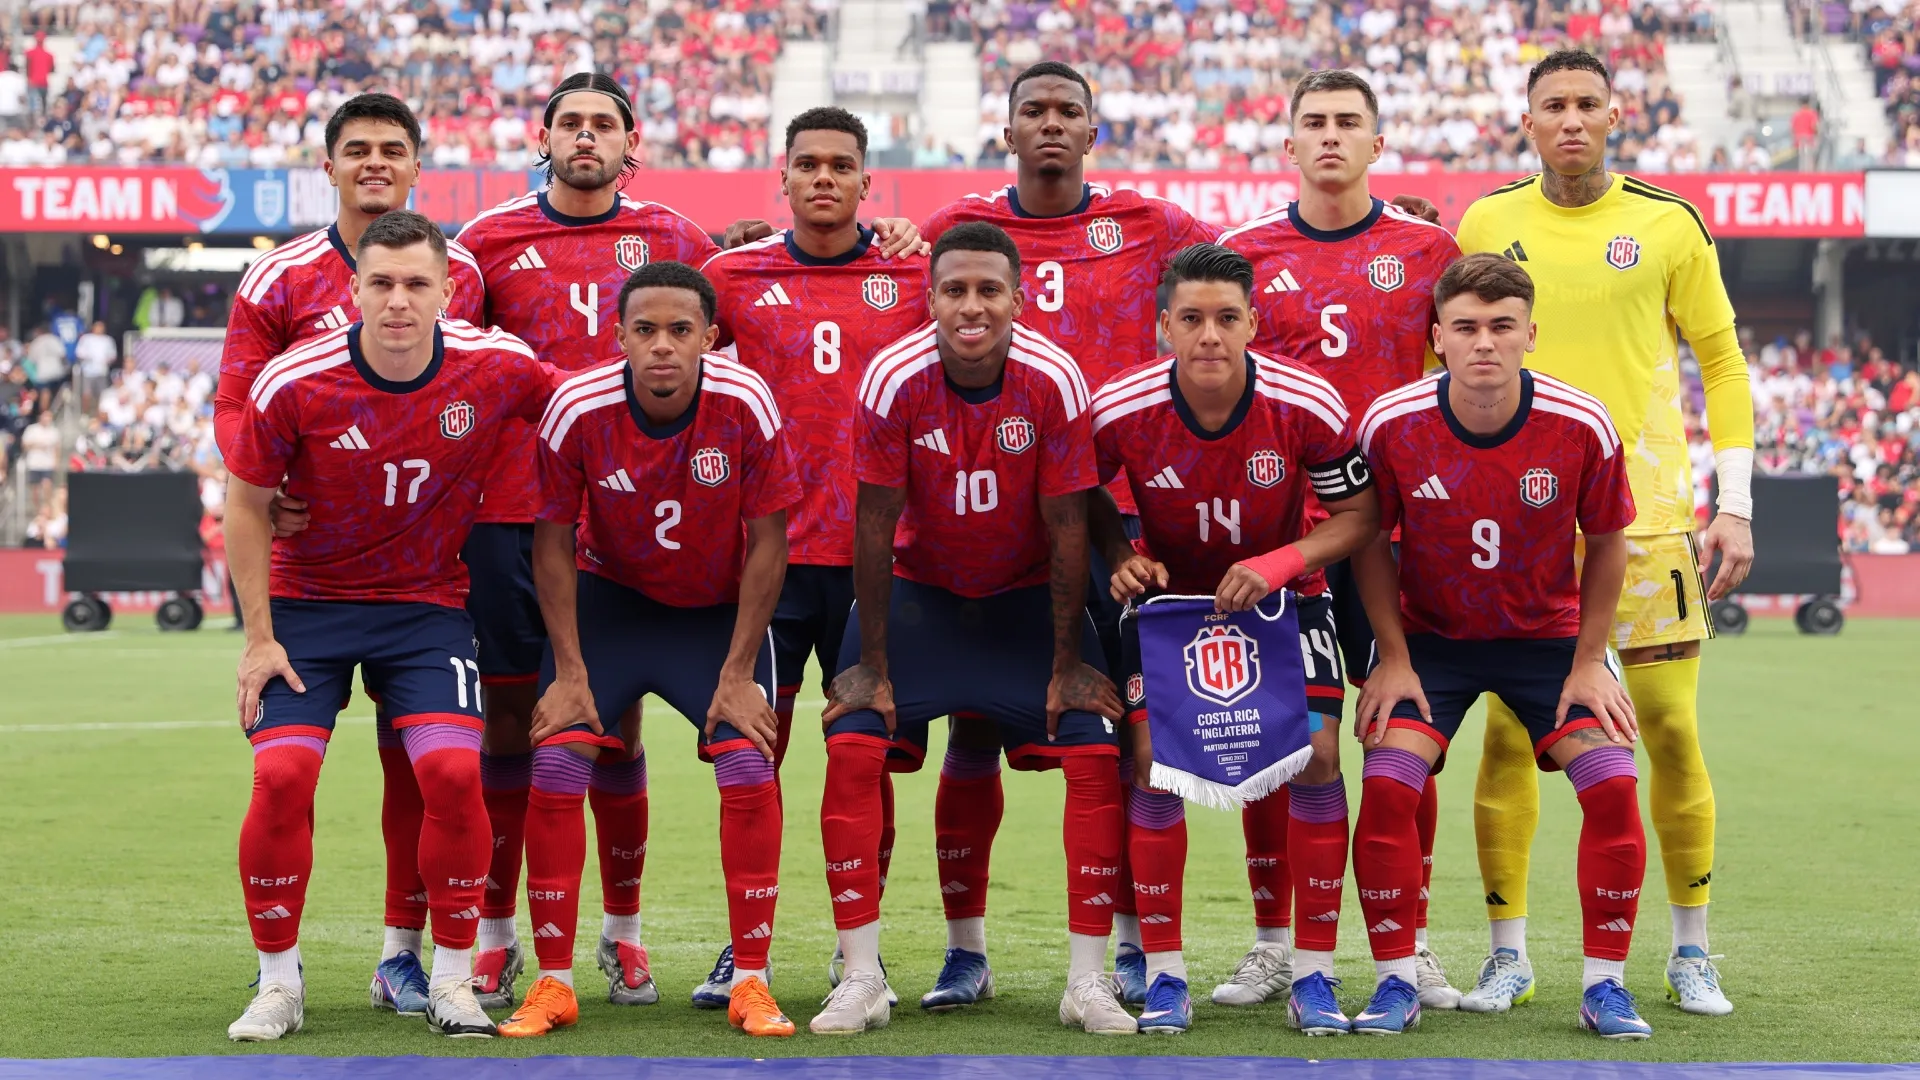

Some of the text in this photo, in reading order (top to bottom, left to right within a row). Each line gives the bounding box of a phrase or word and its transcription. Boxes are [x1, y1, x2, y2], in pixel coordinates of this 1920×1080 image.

[13, 177, 143, 221] TEAM
[1706, 183, 1833, 226] TEAM
[1094, 224, 1115, 247] CR
[623, 241, 642, 269] CR
[1612, 241, 1633, 264] CR
[1376, 262, 1397, 285] CR
[870, 281, 890, 304] CR
[1036, 261, 1064, 312] 3
[570, 282, 598, 337] 4
[1320, 304, 1348, 358] 5
[813, 320, 841, 375] 8
[447, 408, 467, 434] CR
[1004, 424, 1027, 448] CR
[700, 455, 722, 480] CR
[1255, 458, 1277, 482] CR
[1346, 455, 1369, 486] C
[383, 458, 430, 507] 17
[955, 469, 998, 516] 10
[1528, 476, 1549, 501] CR
[655, 499, 682, 550] 2
[1195, 497, 1241, 545] 14
[1471, 518, 1500, 570] 9
[1670, 568, 1688, 622] 1
[1204, 613, 1229, 622] FCRF
[1201, 640, 1244, 691] CR
[1299, 629, 1339, 680] 14
[1127, 678, 1143, 701] CR
[1197, 708, 1261, 727] COSTA RICA
[1201, 723, 1261, 739] INGLATERRA
[1204, 740, 1260, 752] PARTIDO AMISTOSO
[827, 858, 862, 872] FCRF
[1081, 866, 1118, 876] FCRF
[250, 874, 298, 887] FCRF
[448, 874, 488, 887] FCRF
[745, 885, 779, 899] FCRF
[1133, 882, 1170, 894] FCRF
[528, 890, 566, 901] FCRF
[1361, 888, 1401, 900] FCRF
[1596, 887, 1640, 900] FCRF
